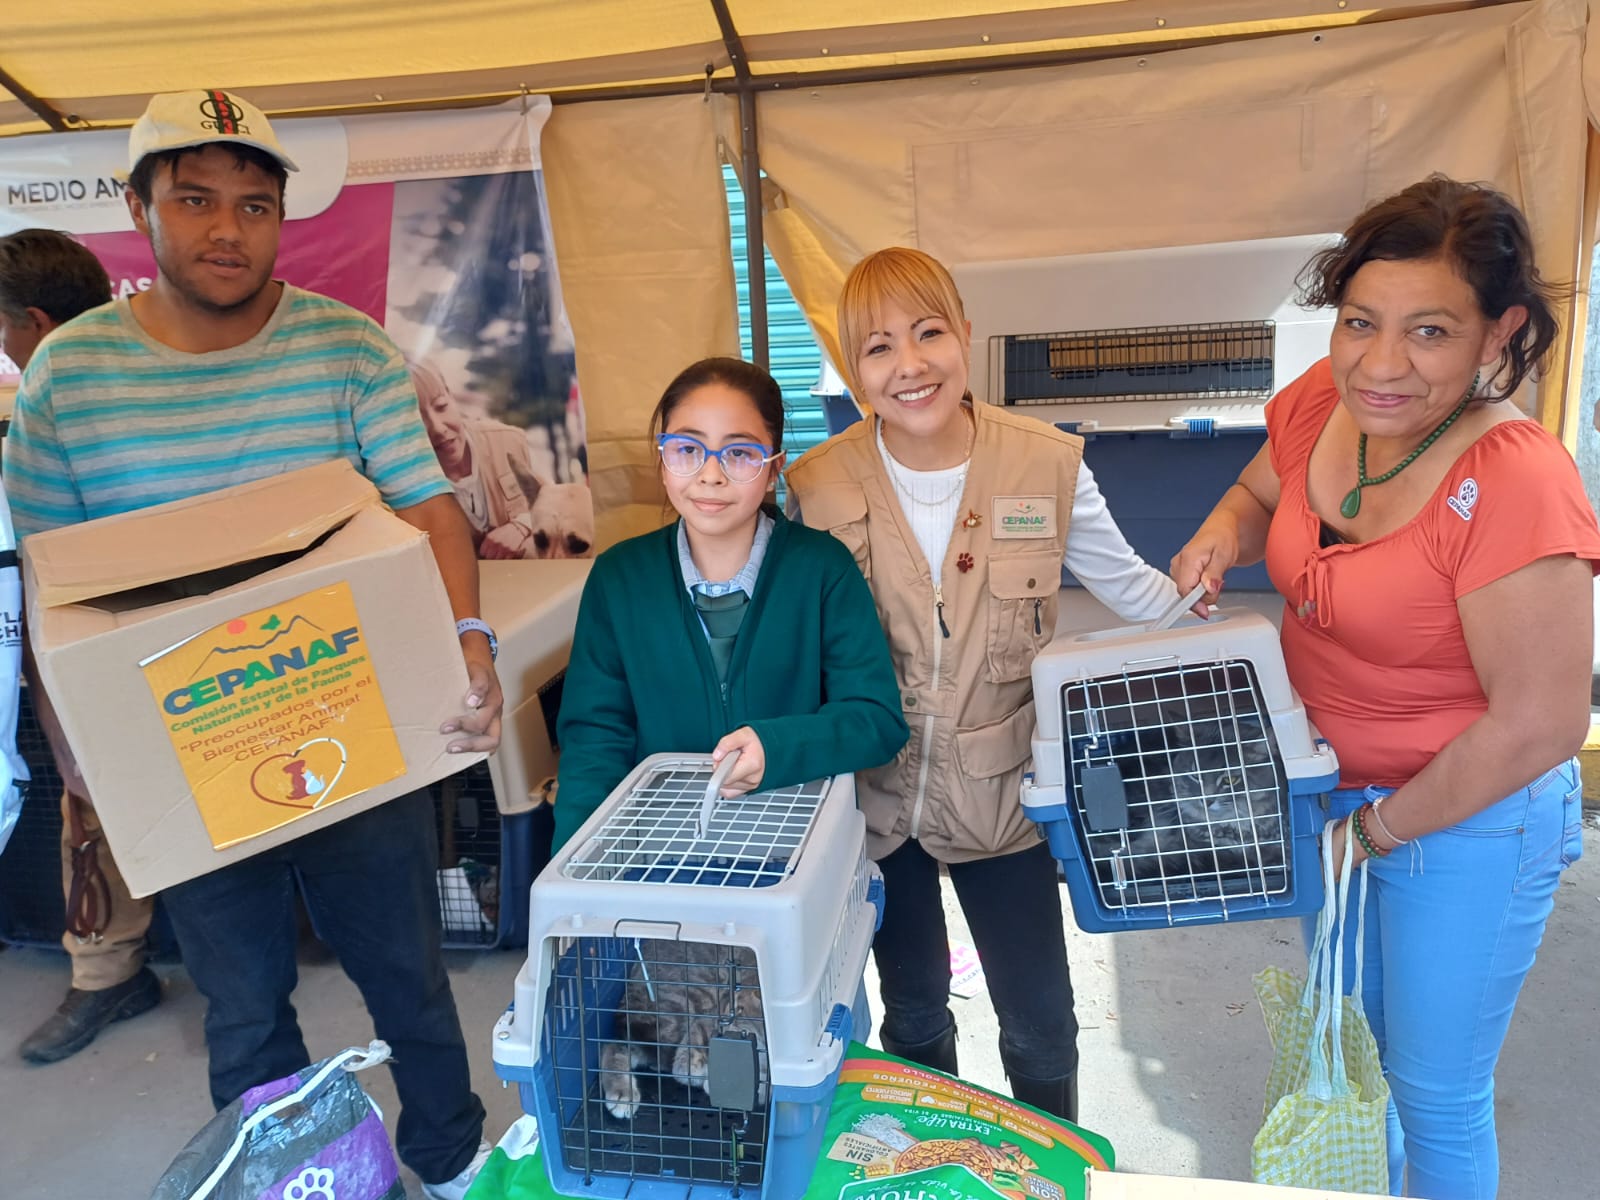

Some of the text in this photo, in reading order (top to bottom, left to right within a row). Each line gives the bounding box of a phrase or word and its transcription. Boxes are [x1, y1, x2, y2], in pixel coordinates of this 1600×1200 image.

[8, 179, 86, 205] MEDIO
[110, 277, 153, 300] AS
[1001, 516, 1048, 525] CEPANAF
[163, 627, 360, 715] CEPANAF
[171, 656, 366, 732] Comisión Estatal de Parques
[321, 685, 350, 703] por
[355, 675, 372, 688] el
[192, 671, 352, 735] Naturales y de la Fauna
[203, 694, 361, 761] Bienestar Animal
[873, 1073, 937, 1089] PEQUEÑOS
[903, 1068, 940, 1082] POLLO
[952, 1090, 987, 1105] MINIS
[953, 1083, 992, 1100] CARNE
[995, 1099, 1019, 1111] CON
[992, 1104, 1047, 1131] ADULTOS
[949, 1120, 990, 1136] EXTRA
[843, 1142, 888, 1157] COLORANTES
[846, 1149, 873, 1163] SIN
[920, 1180, 947, 1189] vida
